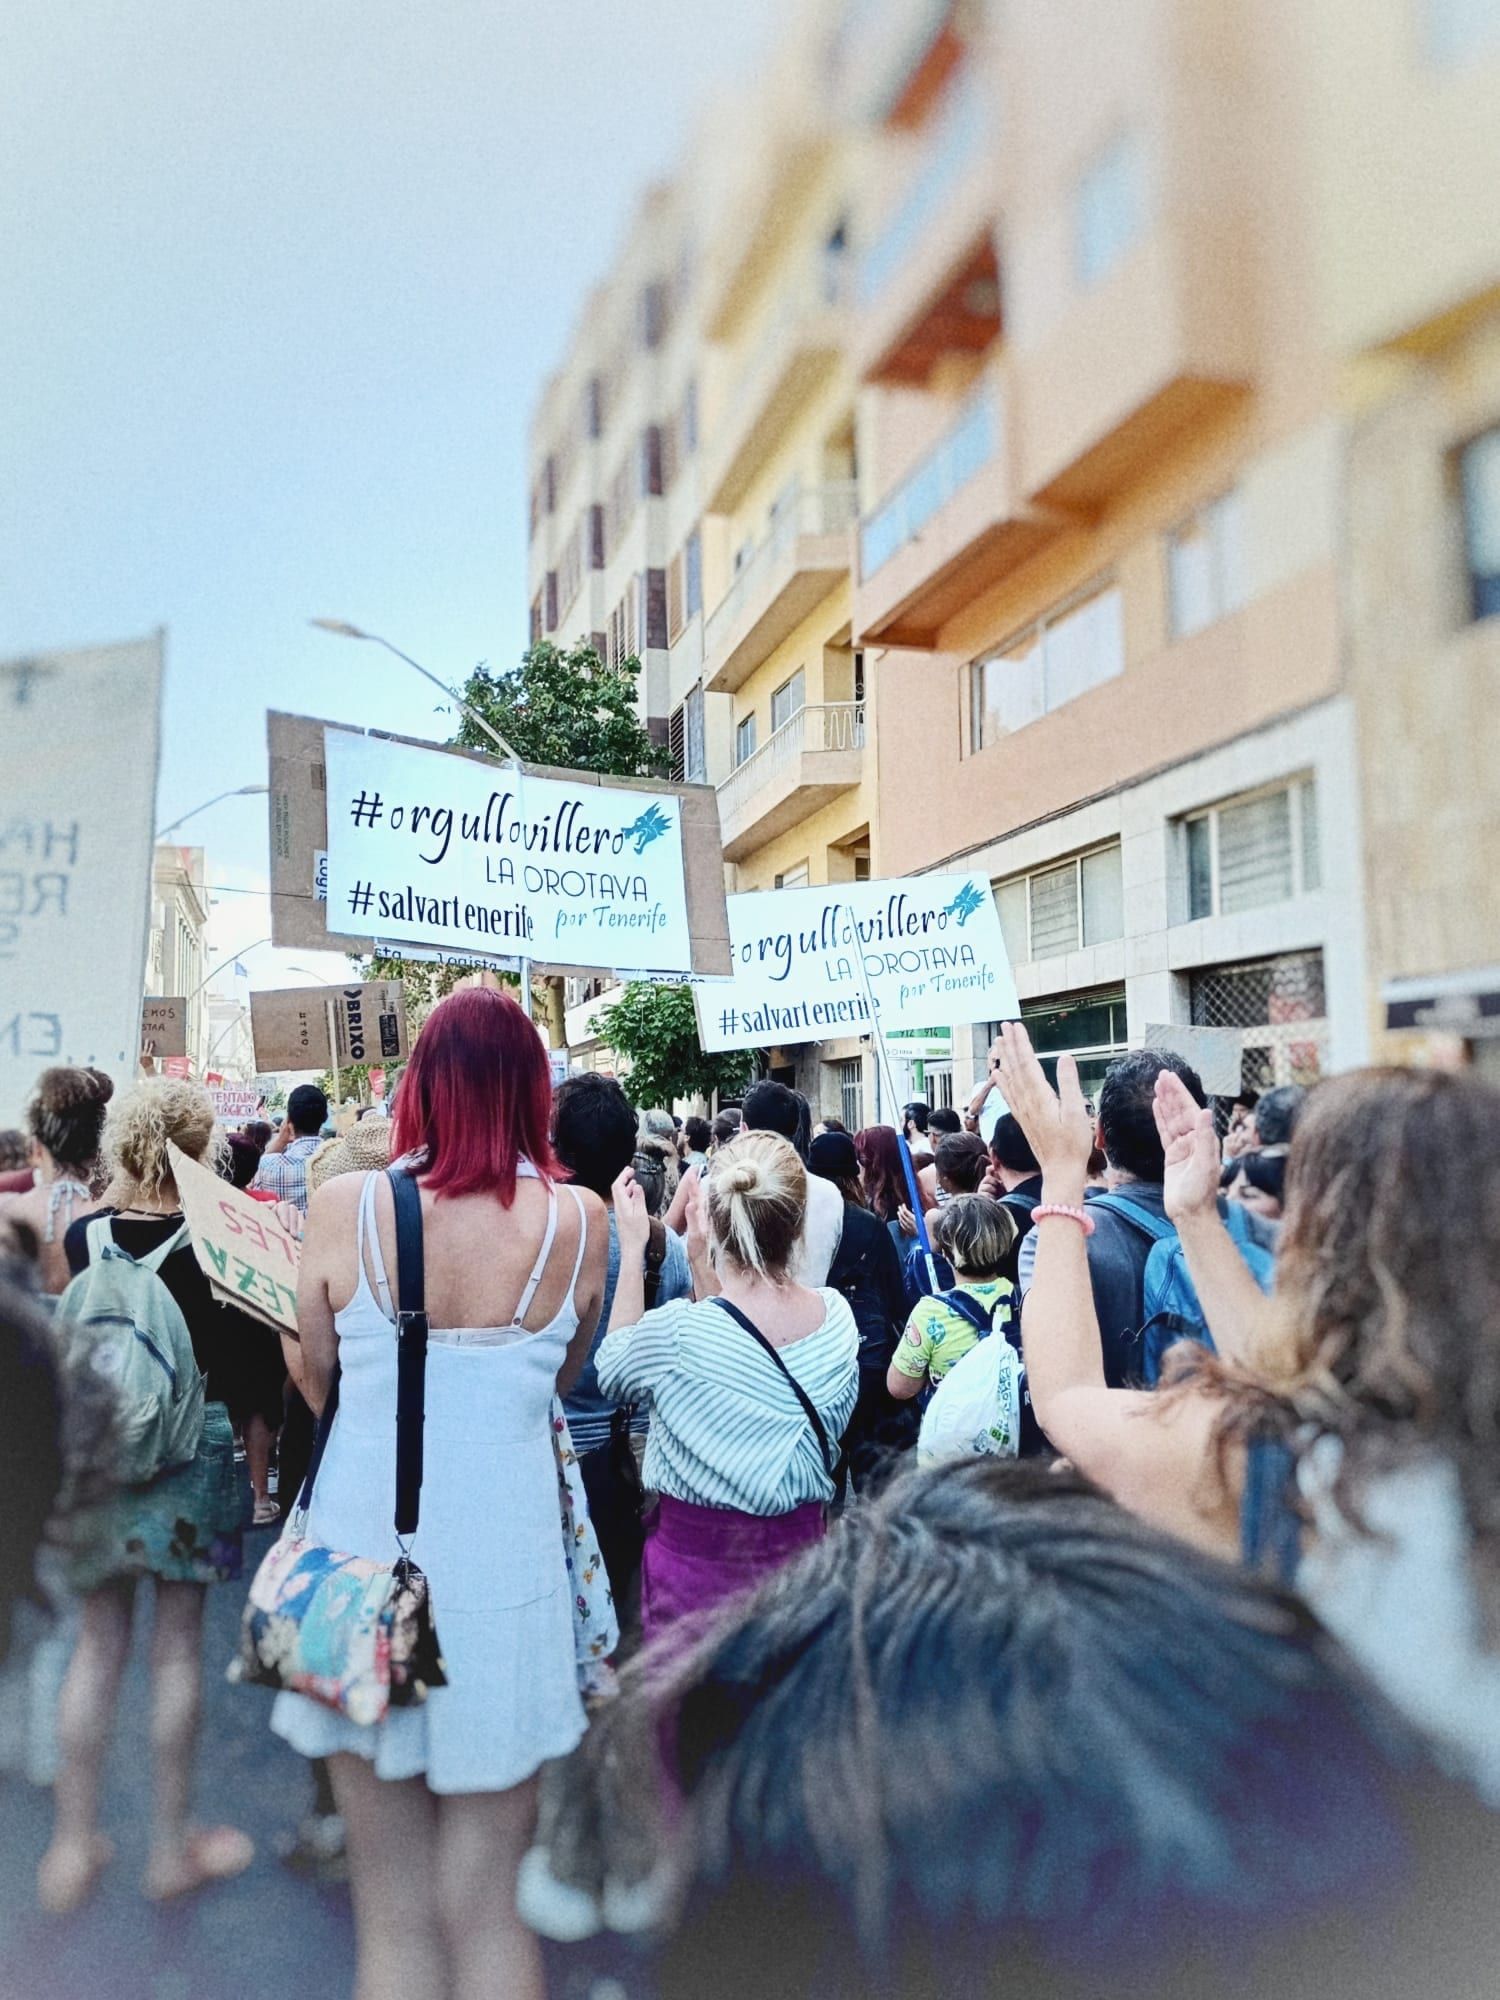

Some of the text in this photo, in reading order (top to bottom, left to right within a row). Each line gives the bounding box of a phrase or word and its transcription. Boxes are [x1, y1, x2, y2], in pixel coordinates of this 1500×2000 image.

[351, 791, 625, 864] #orgullovillero
[486, 856, 648, 902] LA OROTAVA
[348, 880, 535, 941] #salvartenerife
[555, 902, 668, 939] por Tenerife
[730, 894, 948, 981] orgullovillero
[825, 944, 976, 981] LA OROTAVA
[900, 963, 995, 1008] por Tenerife
[346, 1001, 365, 1060] BRIXO
